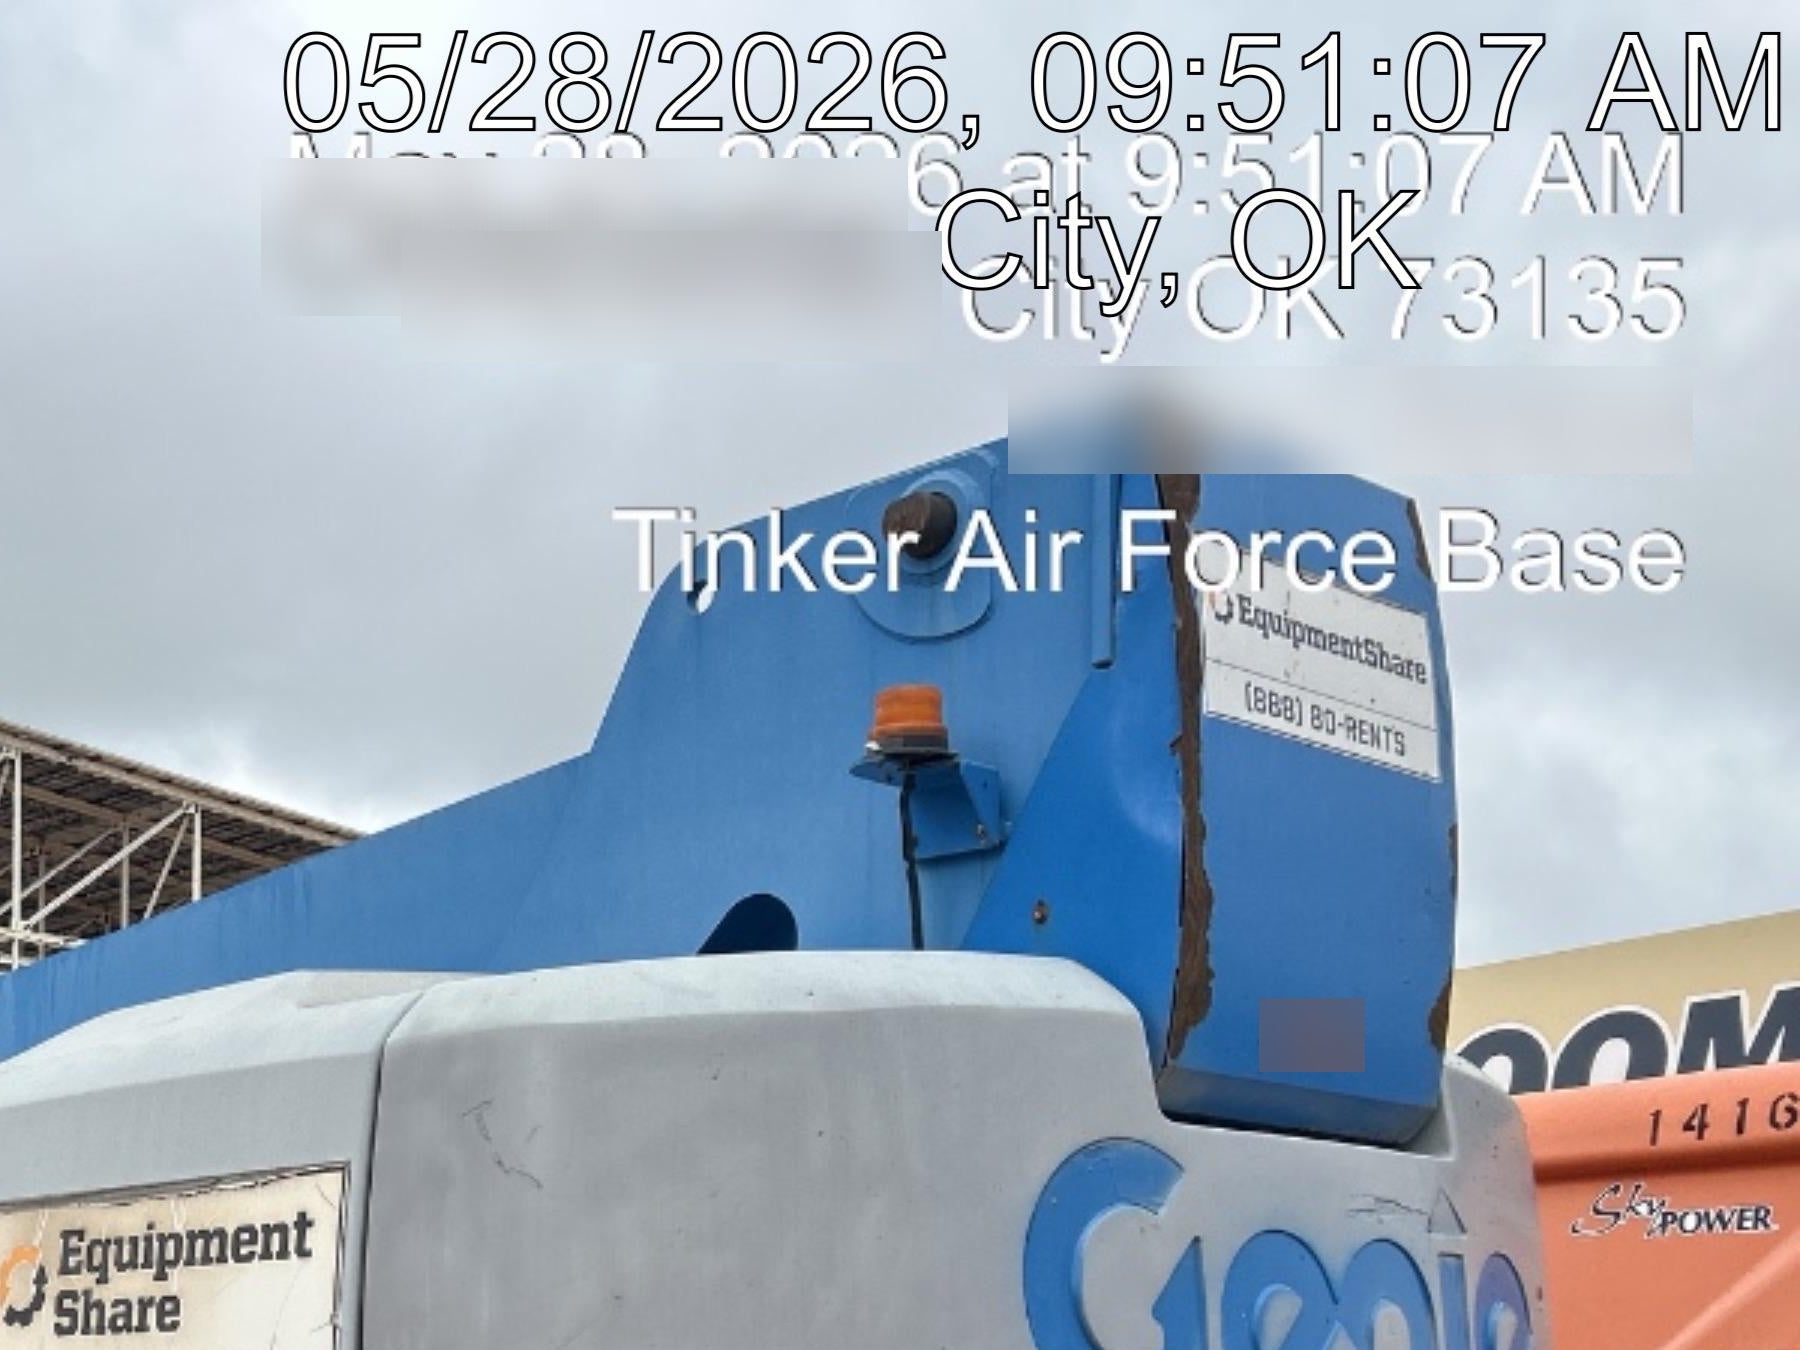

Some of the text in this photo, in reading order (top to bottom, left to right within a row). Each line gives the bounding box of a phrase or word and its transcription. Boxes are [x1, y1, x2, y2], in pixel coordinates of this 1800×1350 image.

[1236, 592, 1429, 685] EquipmentShare
[1310, 703, 1407, 757] 80-RENTS
[58, 1210, 315, 1285] Equipment
[53, 1289, 182, 1336] Share
